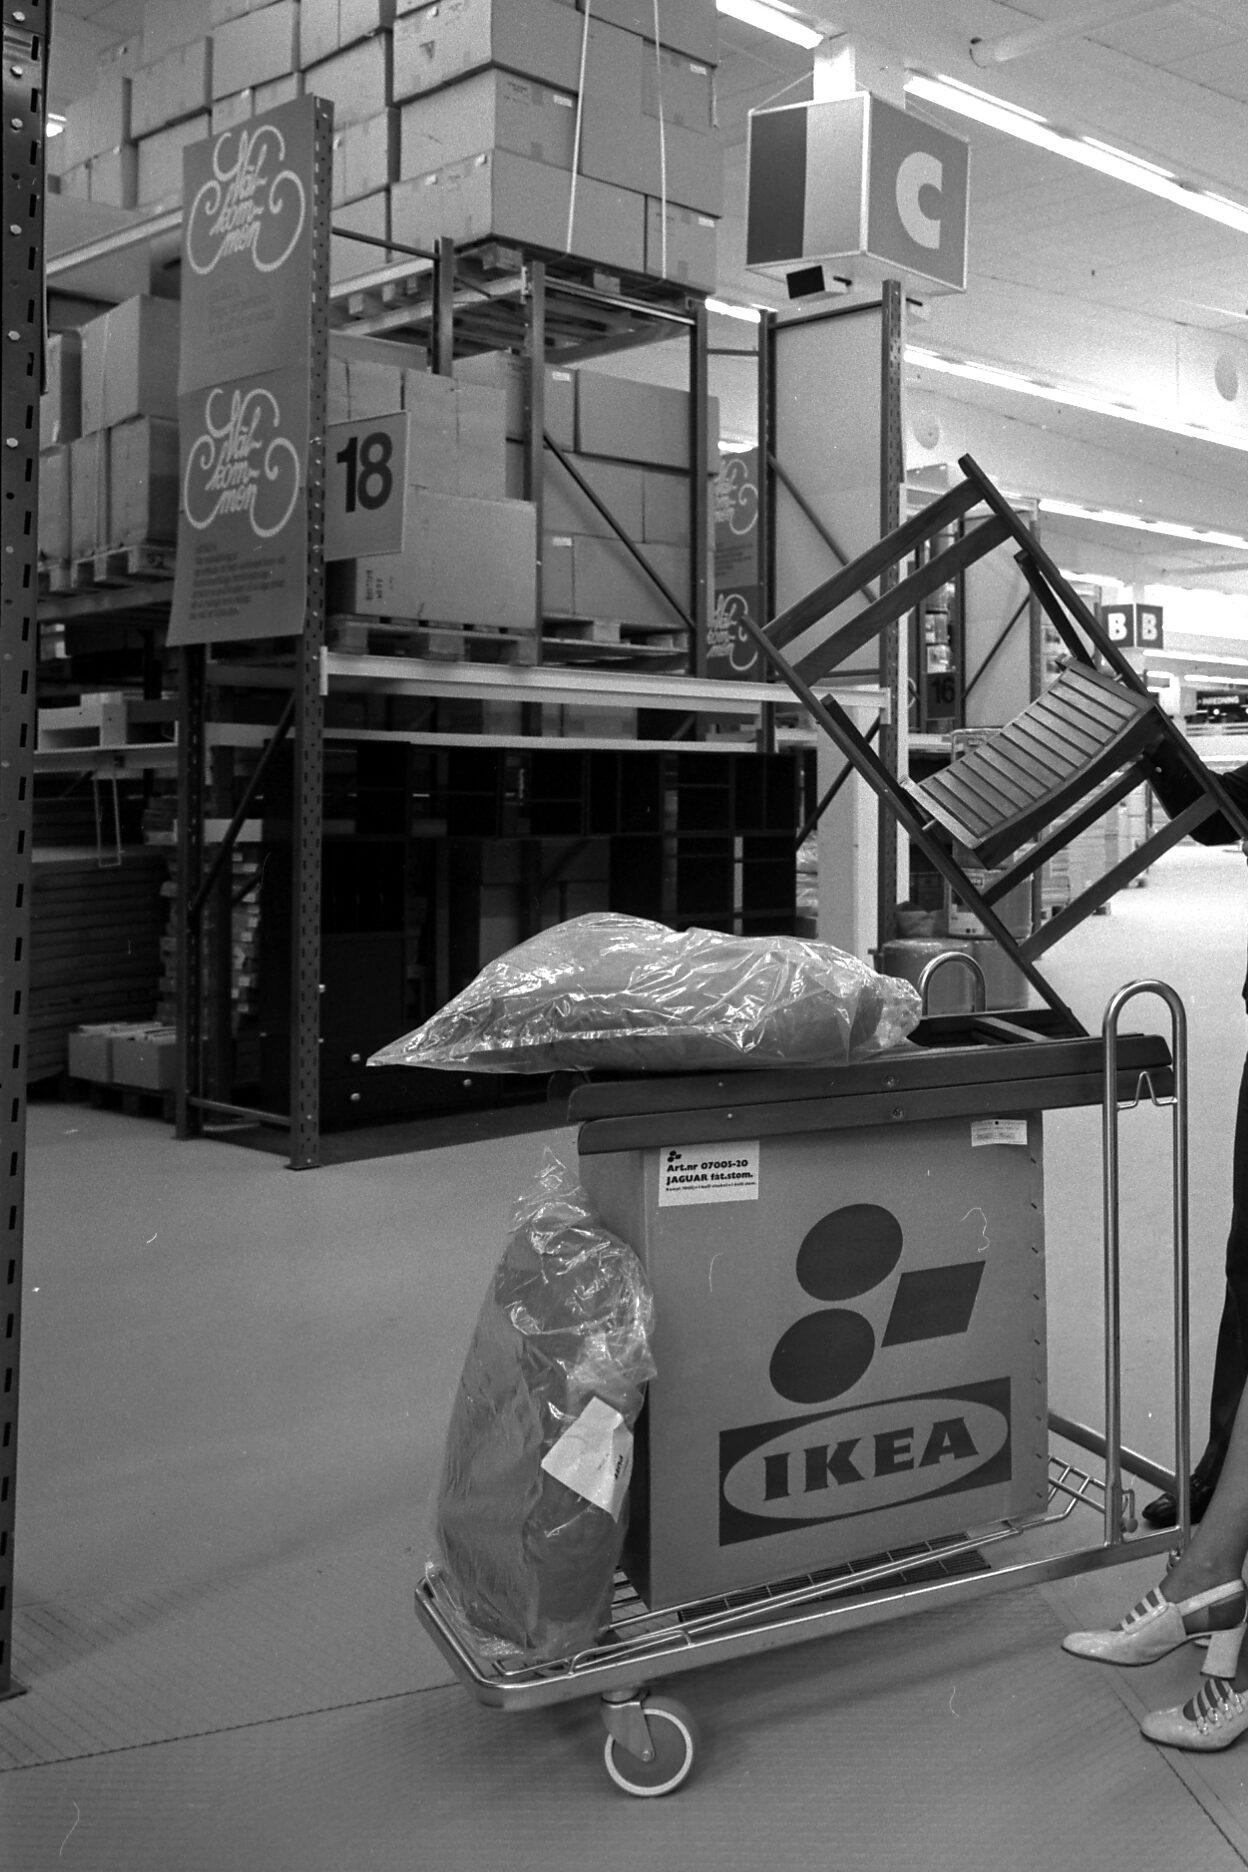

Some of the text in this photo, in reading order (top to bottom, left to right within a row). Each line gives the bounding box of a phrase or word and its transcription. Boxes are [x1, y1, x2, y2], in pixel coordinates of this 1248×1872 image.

[896, 151, 942, 249] C
[336, 431, 393, 513] 18
[1108, 613, 1127, 641] B
[1142, 612, 1158, 641] B
[666, 1173, 708, 1186] JAGUAR
[667, 1159, 748, 1172] Art.nr 07005-20
[763, 1416, 980, 1501] IKEA
